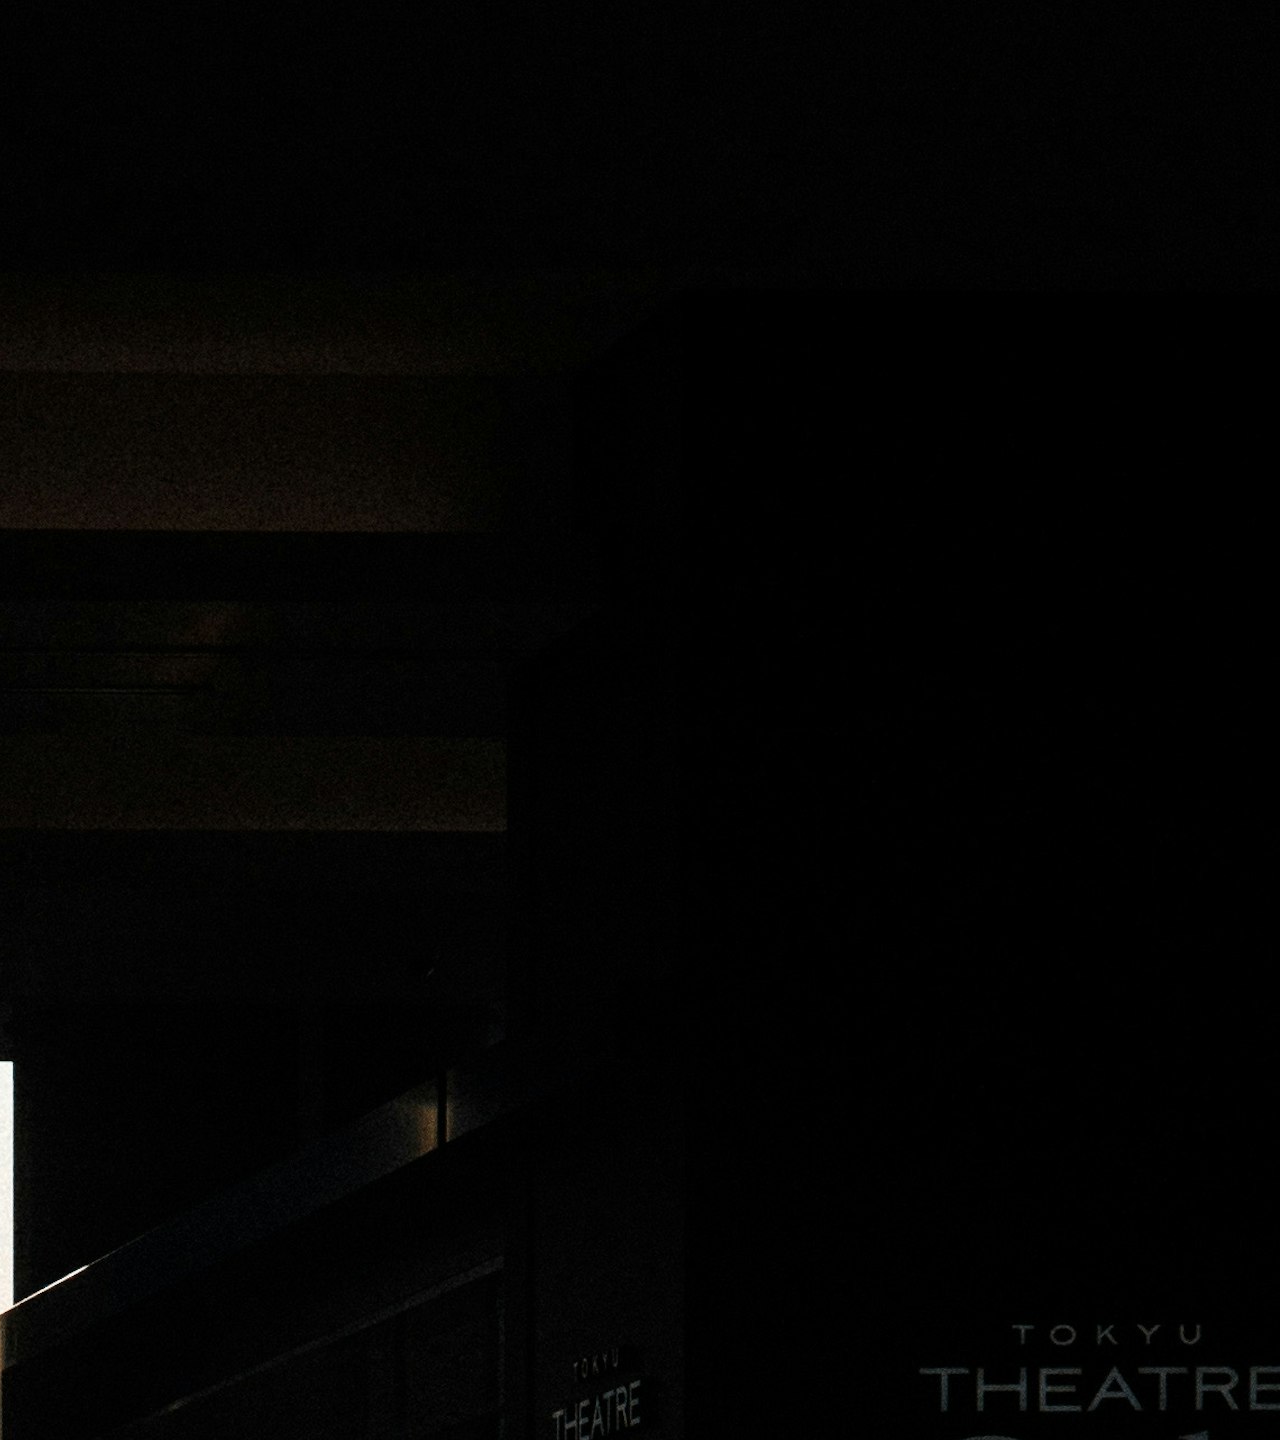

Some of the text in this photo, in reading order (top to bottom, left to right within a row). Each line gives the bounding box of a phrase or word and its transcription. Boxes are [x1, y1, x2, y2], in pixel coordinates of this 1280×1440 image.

[1011, 1323, 1203, 1347] TOKYU
[572, 1348, 619, 1380] TOKYU
[918, 1365, 1280, 1413] THEATRE
